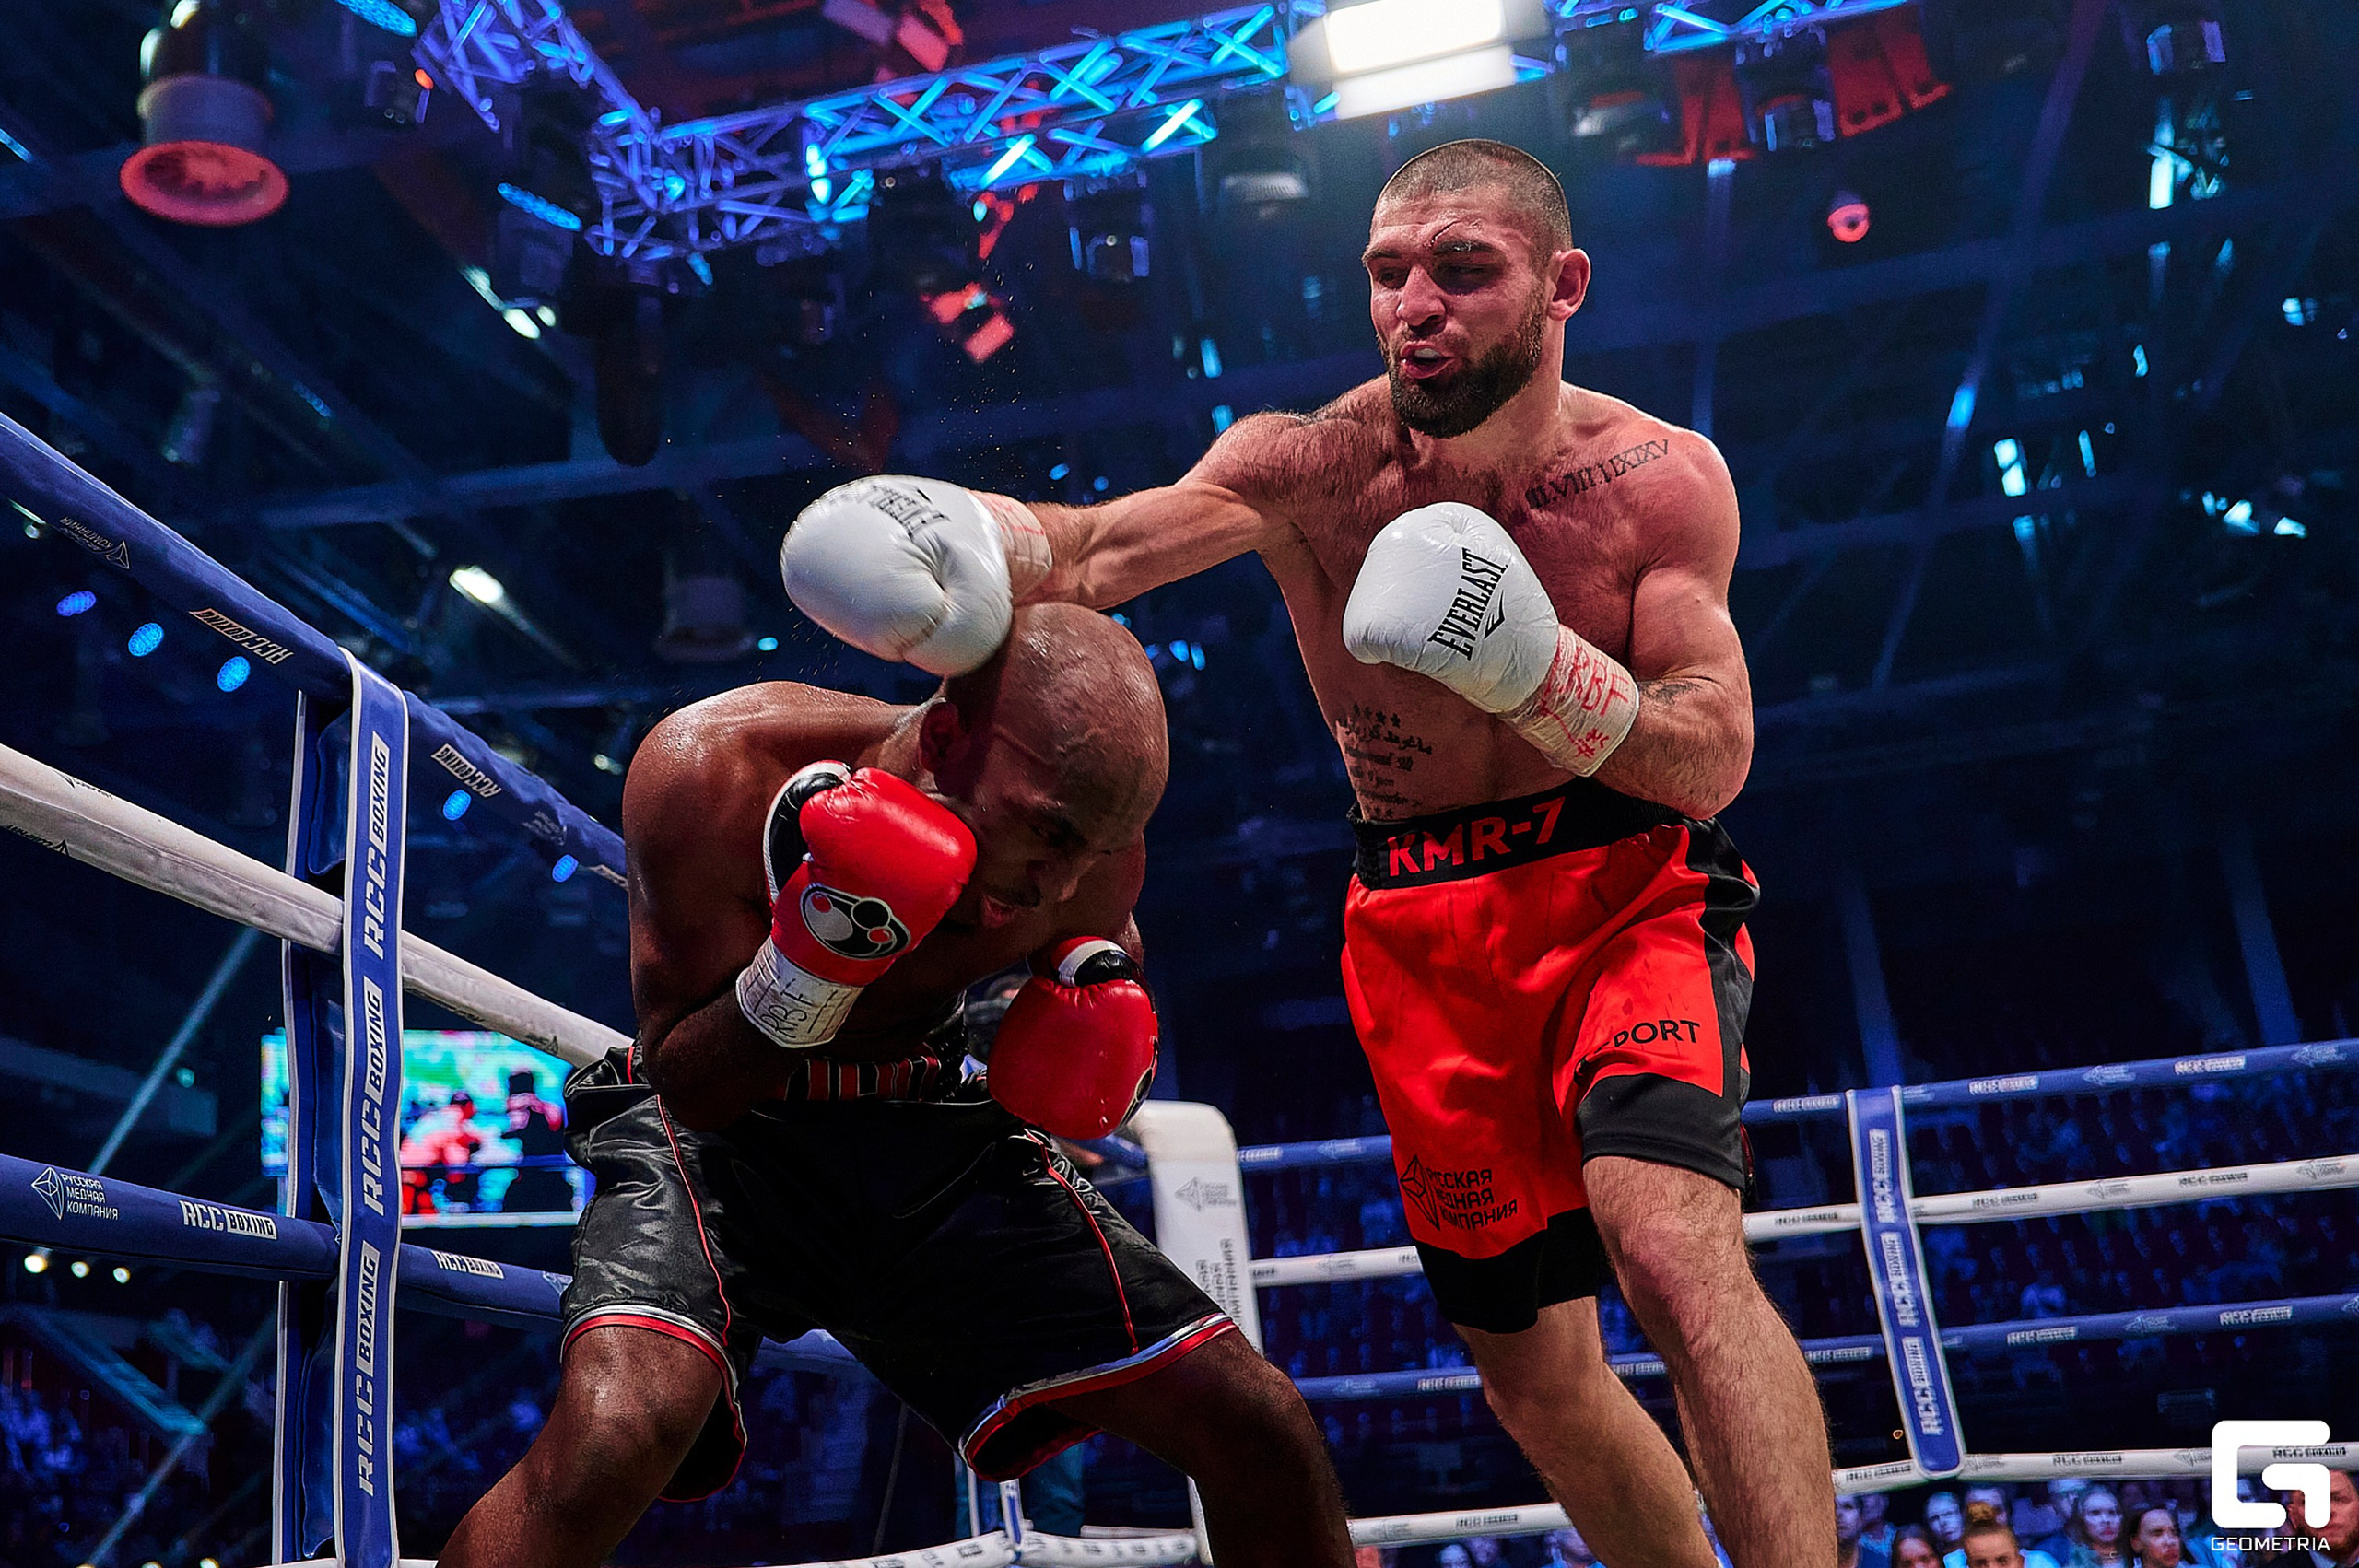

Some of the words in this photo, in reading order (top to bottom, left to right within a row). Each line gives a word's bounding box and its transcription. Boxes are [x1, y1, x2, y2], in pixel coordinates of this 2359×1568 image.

[1427, 547, 1507, 661] EVERLAST
[194, 609, 254, 640] BOXING
[244, 637, 295, 664] RCC
[433, 746, 474, 778] BOXING
[370, 743, 388, 847] BOXING
[464, 771, 502, 798] RCC
[1387, 796, 1566, 876] KMR-7
[364, 846, 387, 960] RCC
[367, 988, 385, 1094] BOXING
[1594, 1019, 1701, 1054] PORT
[361, 1099, 384, 1217] RCC
[60, 1173, 103, 1190] РУССКАЯ
[66, 1187, 106, 1203] МЕДНАЯ
[66, 1199, 119, 1221] КОМПАНИЯ
[179, 1200, 224, 1231] RCC
[227, 1211, 276, 1237] BOXING
[431, 1250, 467, 1273] RCC
[358, 1253, 377, 1365] BOXING
[356, 1374, 374, 1496] RCC
